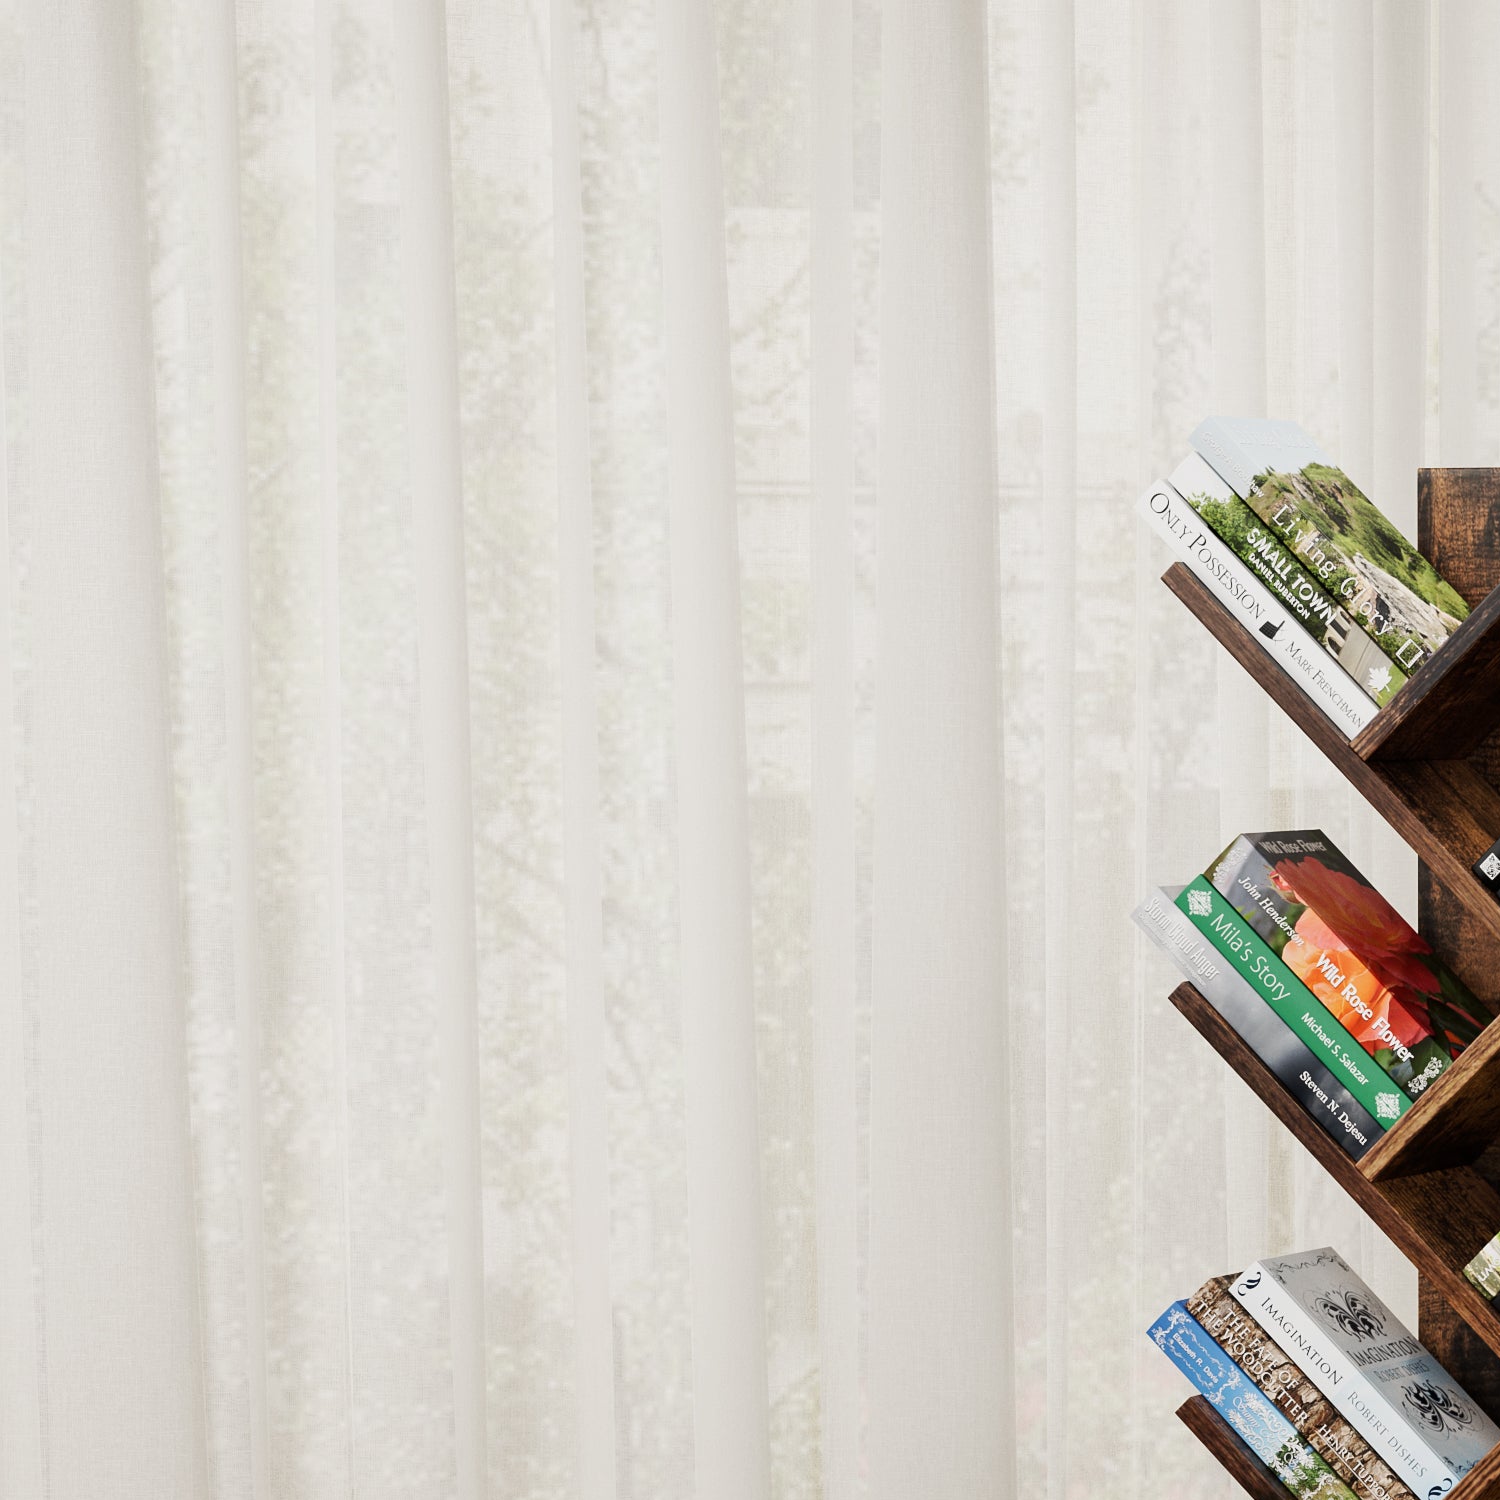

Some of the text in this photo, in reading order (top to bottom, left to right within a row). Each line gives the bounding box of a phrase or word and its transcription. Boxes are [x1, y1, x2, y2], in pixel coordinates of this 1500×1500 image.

[1246, 527, 1337, 625] SMALL TOWN
[1248, 553, 1310, 619] DANIEL RUBERTON
[1144, 897, 1171, 930] Storm
[1168, 924, 1197, 953] Cloud
[1190, 947, 1219, 983] Anger
[1239, 875, 1304, 946] John Henderson
[1210, 913, 1290, 1005] Mila's Story
[1302, 1013, 1368, 1085] Michael S. Salazar
[1314, 954, 1414, 1064] Wild Rose Flower
[1299, 1070, 1367, 1145] Steven N. Dejesu
[1173, 1333, 1219, 1383] Elizabeth R. Davis
[1196, 1301, 1222, 1330] THE
[1220, 1329, 1309, 1425] WOODCUTTER
[1222, 1309, 1299, 1391] THE FATE OF
